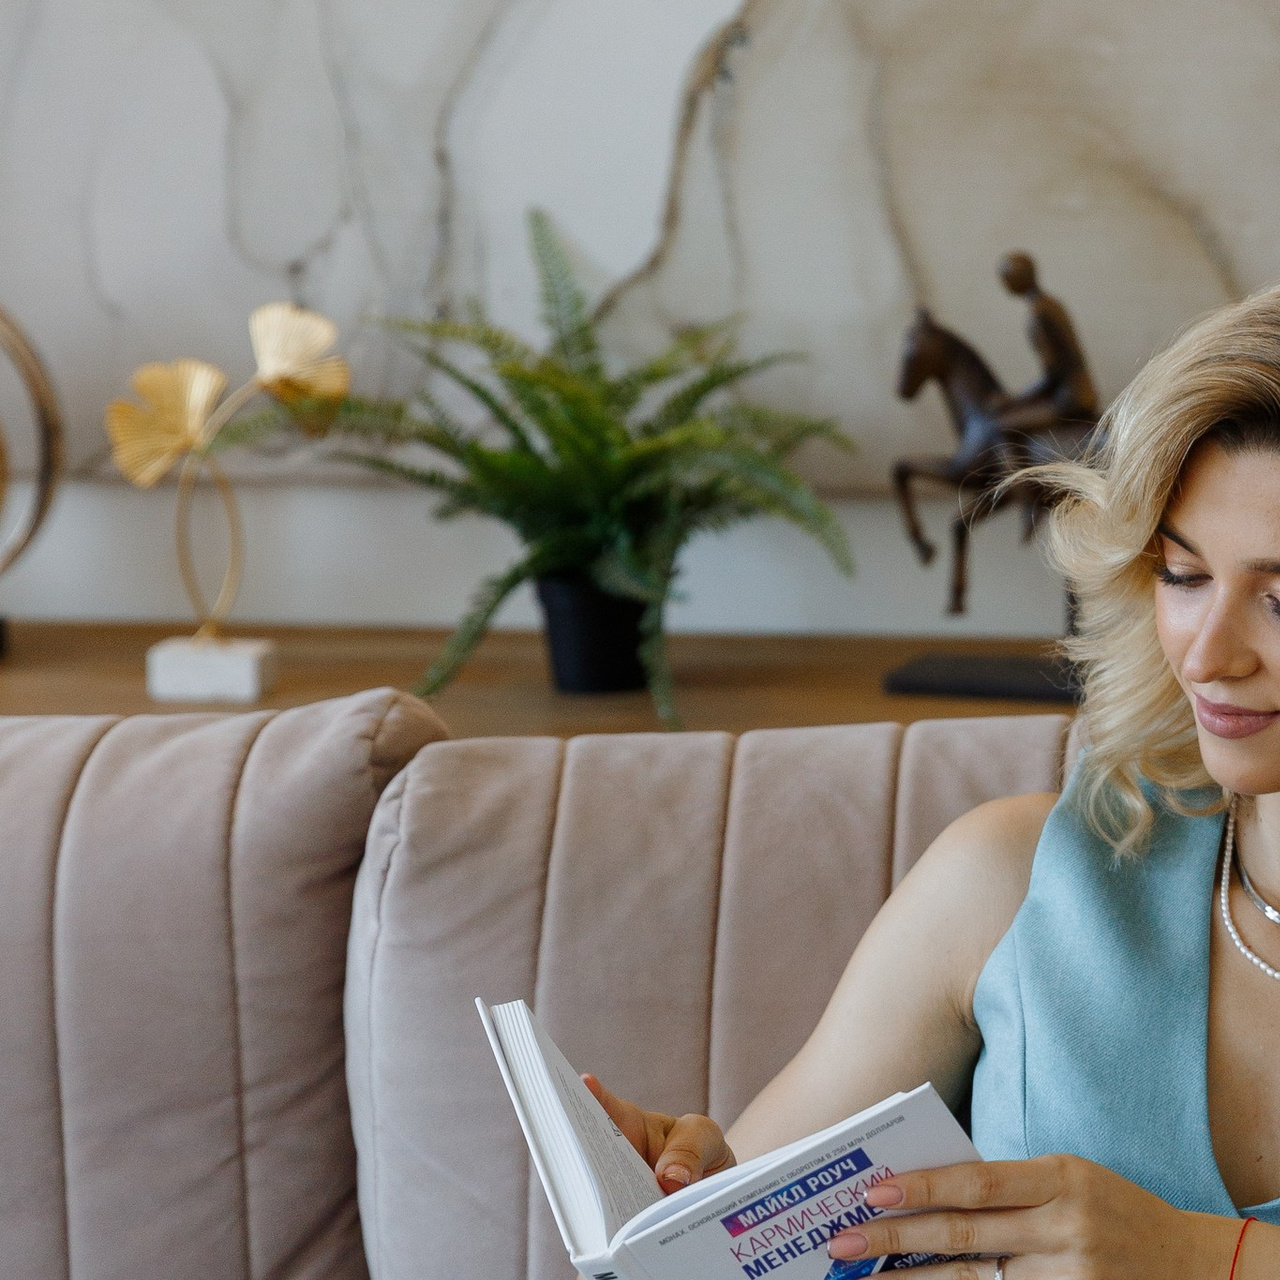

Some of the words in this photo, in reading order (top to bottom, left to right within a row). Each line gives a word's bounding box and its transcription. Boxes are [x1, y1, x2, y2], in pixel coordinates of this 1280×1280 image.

[688, 1199, 738, 1232] ОСНОВАВШИЙ
[737, 1177, 780, 1206] КОМПАНИЮ
[786, 1154, 826, 1180] ОБОРОТОМ
[831, 1145, 848, 1159] 250
[847, 1135, 866, 1151] МЛН
[729, 1164, 896, 1263] КАРМИЧЕСКИЙ
[737, 1183, 806, 1228] МАЙКЛ
[806, 1157, 859, 1196] РОУЧ
[742, 1198, 889, 1280] МЕНЕДЖМЕ
